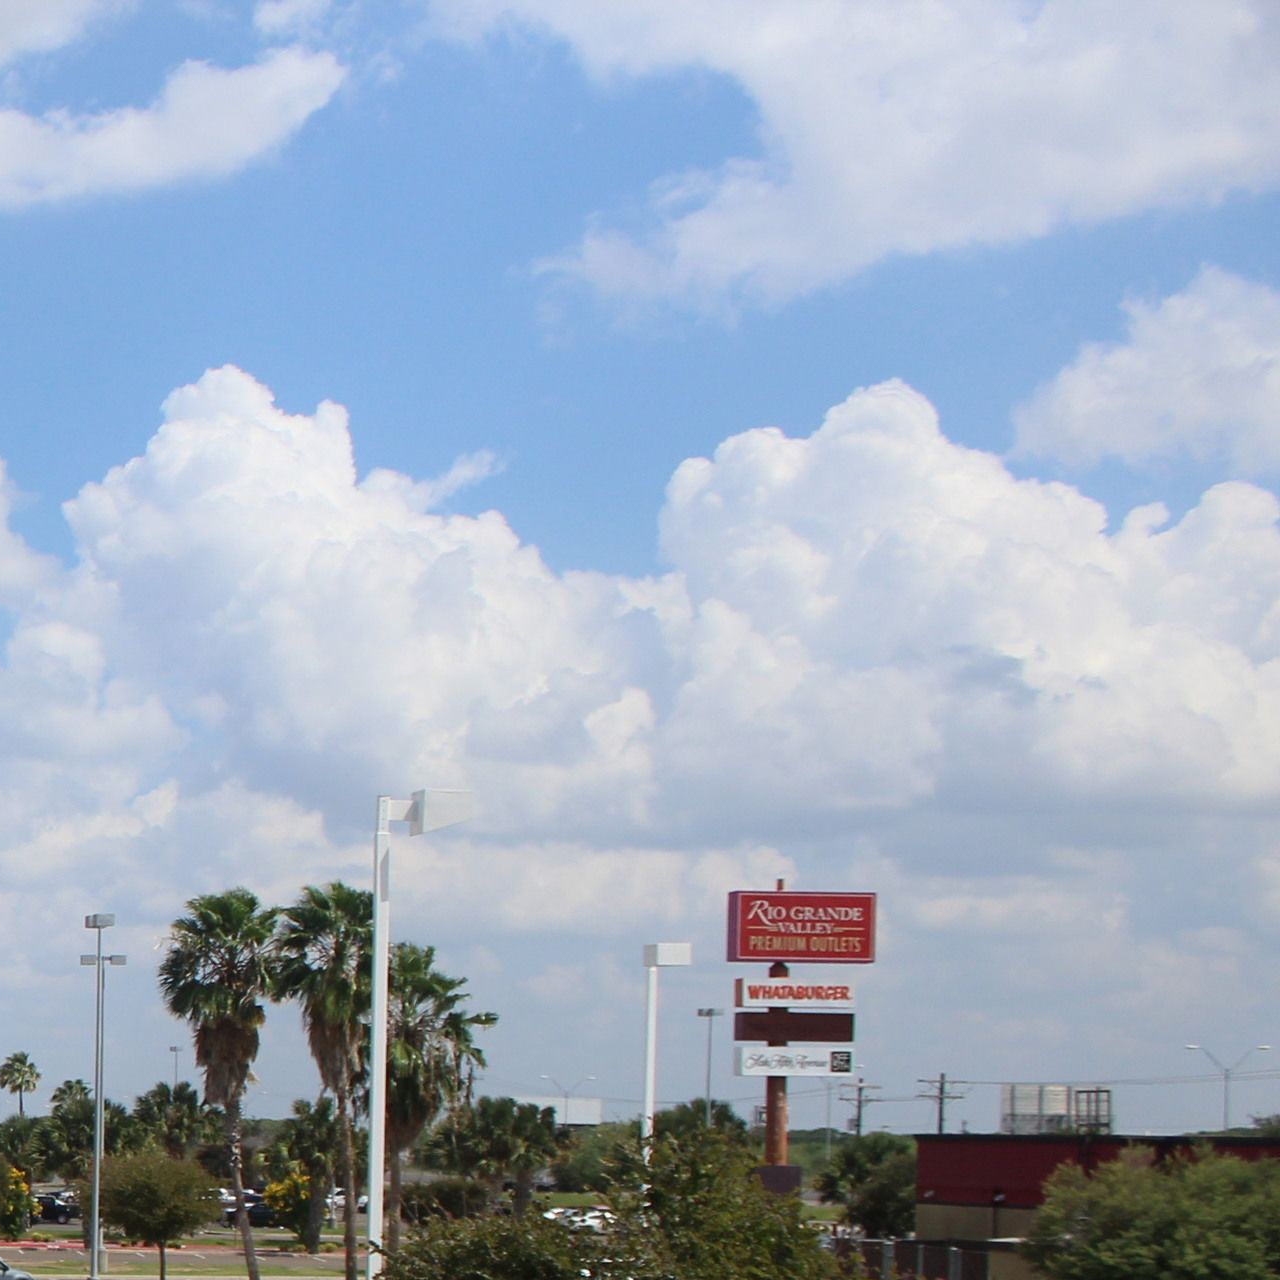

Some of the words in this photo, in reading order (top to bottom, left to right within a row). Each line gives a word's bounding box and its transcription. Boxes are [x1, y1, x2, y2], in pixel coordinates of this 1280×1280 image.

[789, 906, 865, 922] GRANDE
[777, 922, 835, 935] VALLEY
[749, 936, 807, 952] PREMIUM
[810, 937, 861, 953] OUTLETS
[747, 985, 850, 1000] WHATABURGER
